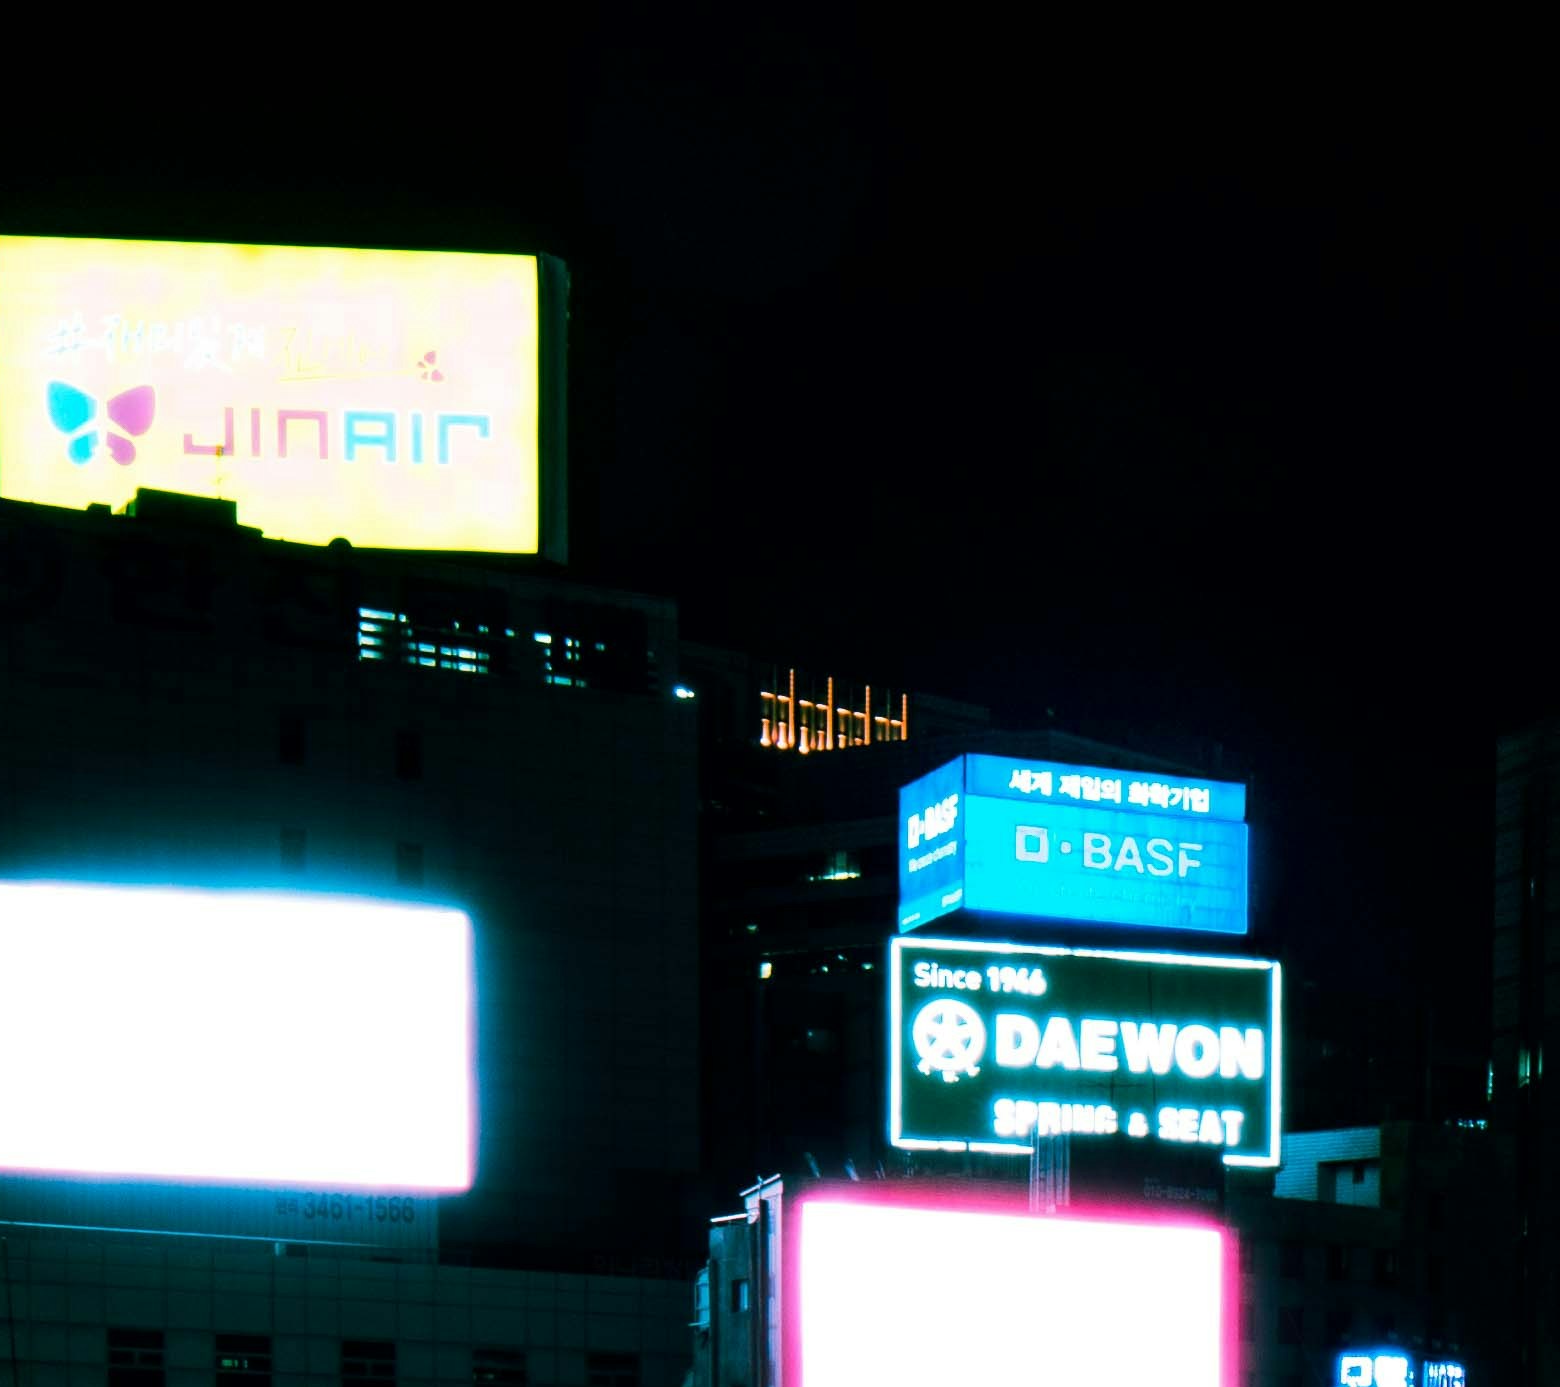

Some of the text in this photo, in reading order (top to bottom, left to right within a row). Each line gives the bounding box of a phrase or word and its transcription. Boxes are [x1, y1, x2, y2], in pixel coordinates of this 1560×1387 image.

[1008, 768, 1210, 814] 세계 제일의 화학기업
[1083, 833, 1203, 878] BASF
[913, 961, 981, 992] Since
[995, 1013, 1264, 1079] DAEWON
[992, 1099, 1118, 1138] SPRING
[1158, 1106, 1244, 1147] SEAT
